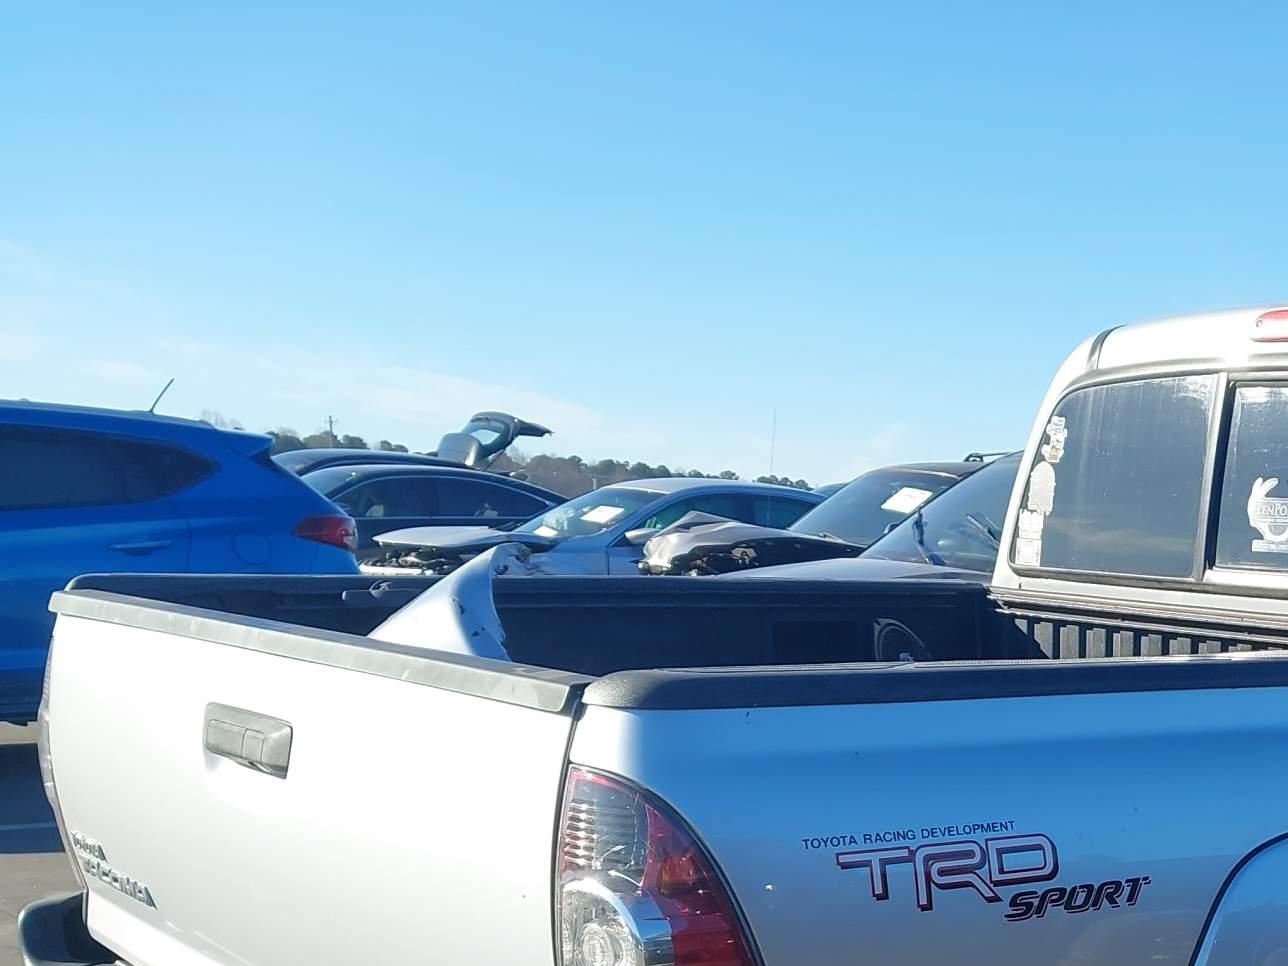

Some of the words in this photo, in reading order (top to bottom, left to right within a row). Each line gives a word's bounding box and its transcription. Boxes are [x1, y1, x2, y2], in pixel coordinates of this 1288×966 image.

[802, 834, 857, 851] TOYOTA
[863, 828, 917, 845] RACING
[919, 820, 1016, 840] DEVELOPMENT
[835, 832, 1060, 912] TRD
[1003, 875, 1153, 922] SPORT
